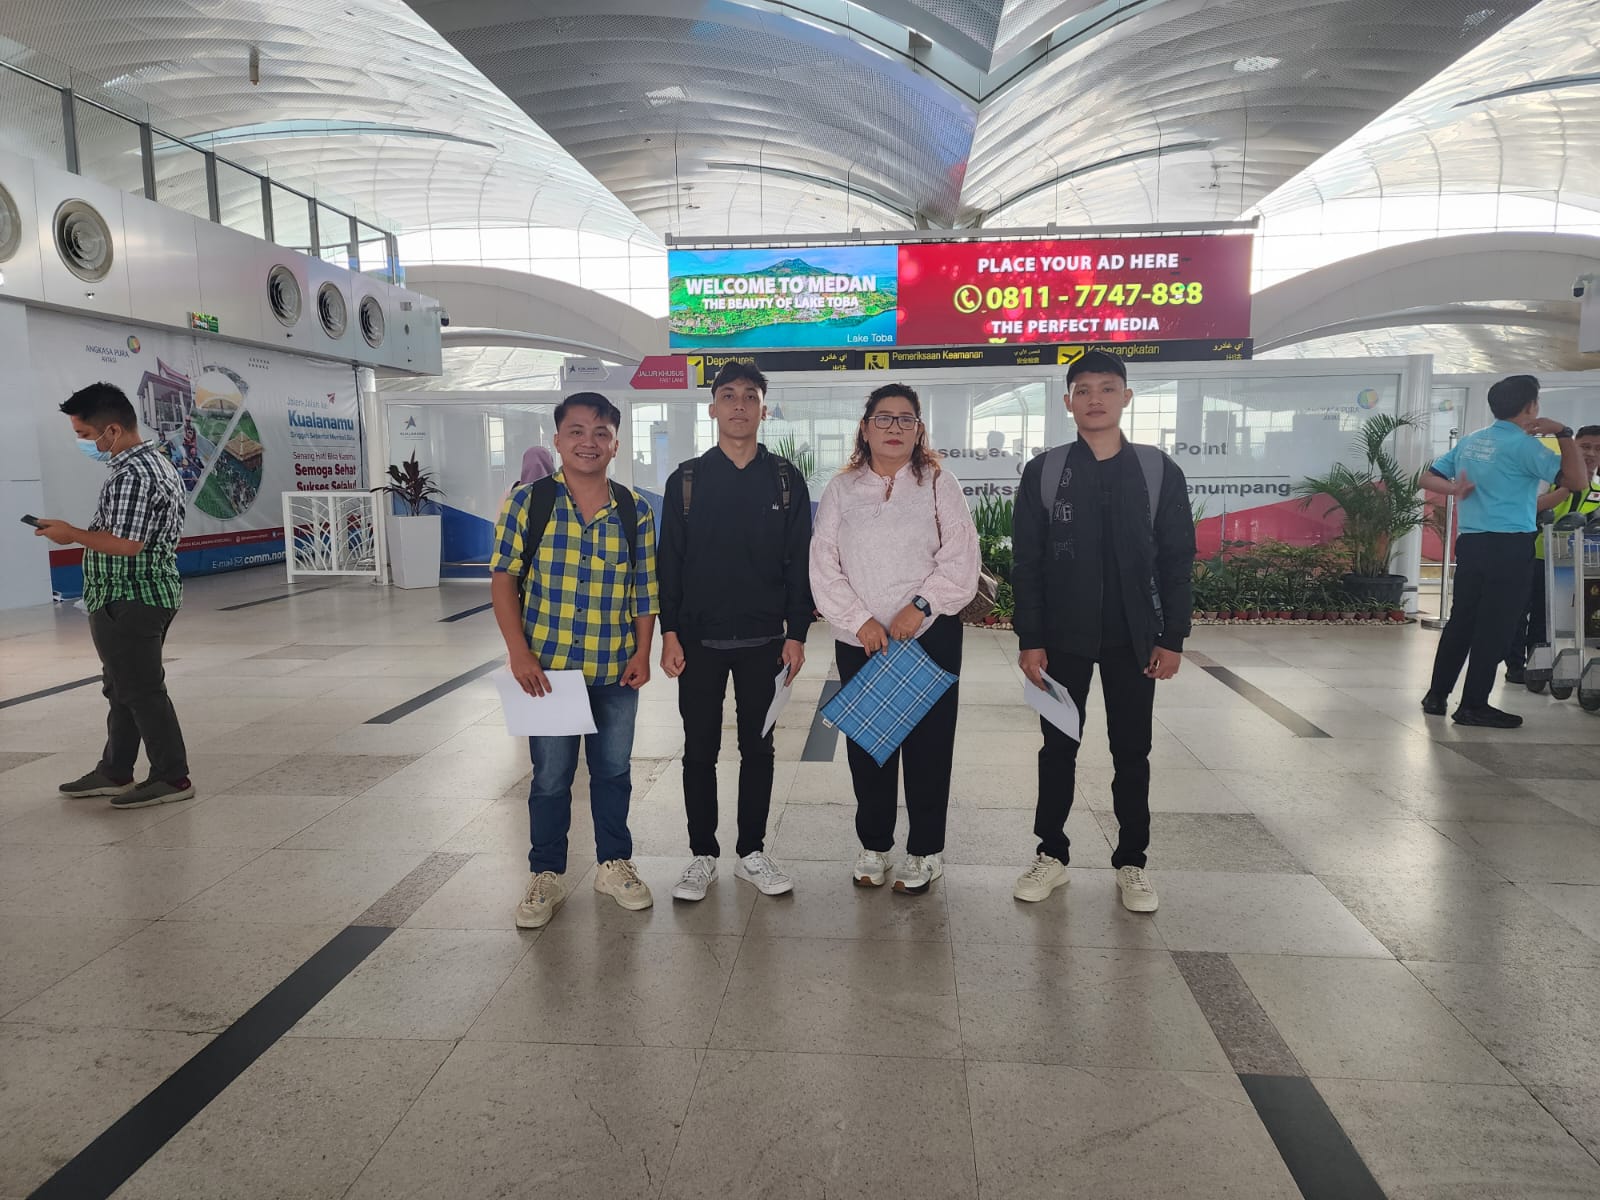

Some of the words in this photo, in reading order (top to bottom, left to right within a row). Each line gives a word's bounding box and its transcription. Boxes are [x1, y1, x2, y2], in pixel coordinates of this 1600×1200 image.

[978, 257, 1035, 273] PLACE
[1040, 256, 1092, 271] YOUR
[1097, 255, 1125, 270] AD
[1130, 253, 1179, 269] HERE
[686, 278, 777, 295] WELCOME
[778, 277, 803, 294] TO
[808, 275, 876, 293] MEDAN
[703, 298, 726, 311] THE
[727, 297, 774, 311] BEAUTY
[775, 297, 793, 309] OF
[794, 297, 826, 309] LAKE
[827, 296, 859, 308] TOBA
[986, 286, 1050, 310] 0811
[991, 320, 1026, 334] THE
[1028, 318, 1099, 333] PERFECT
[1104, 317, 1160, 331] MEDIA
[847, 333, 869, 343] Lake
[871, 333, 893, 343] Toba
[892, 352, 941, 361] Pemeriksaan
[942, 351, 984, 360] Keamanan
[639, 370, 658, 378] JALUR
[287, 409, 354, 431] Kualanamu
[940, 447, 1007, 460] senger
[1175, 442, 1228, 455] Point
[295, 463, 333, 478] Semoga
[335, 463, 356, 476] Sehat
[297, 481, 330, 491] Sukses
[962, 483, 1020, 496] eriks
[1186, 483, 1291, 496] enumpang
